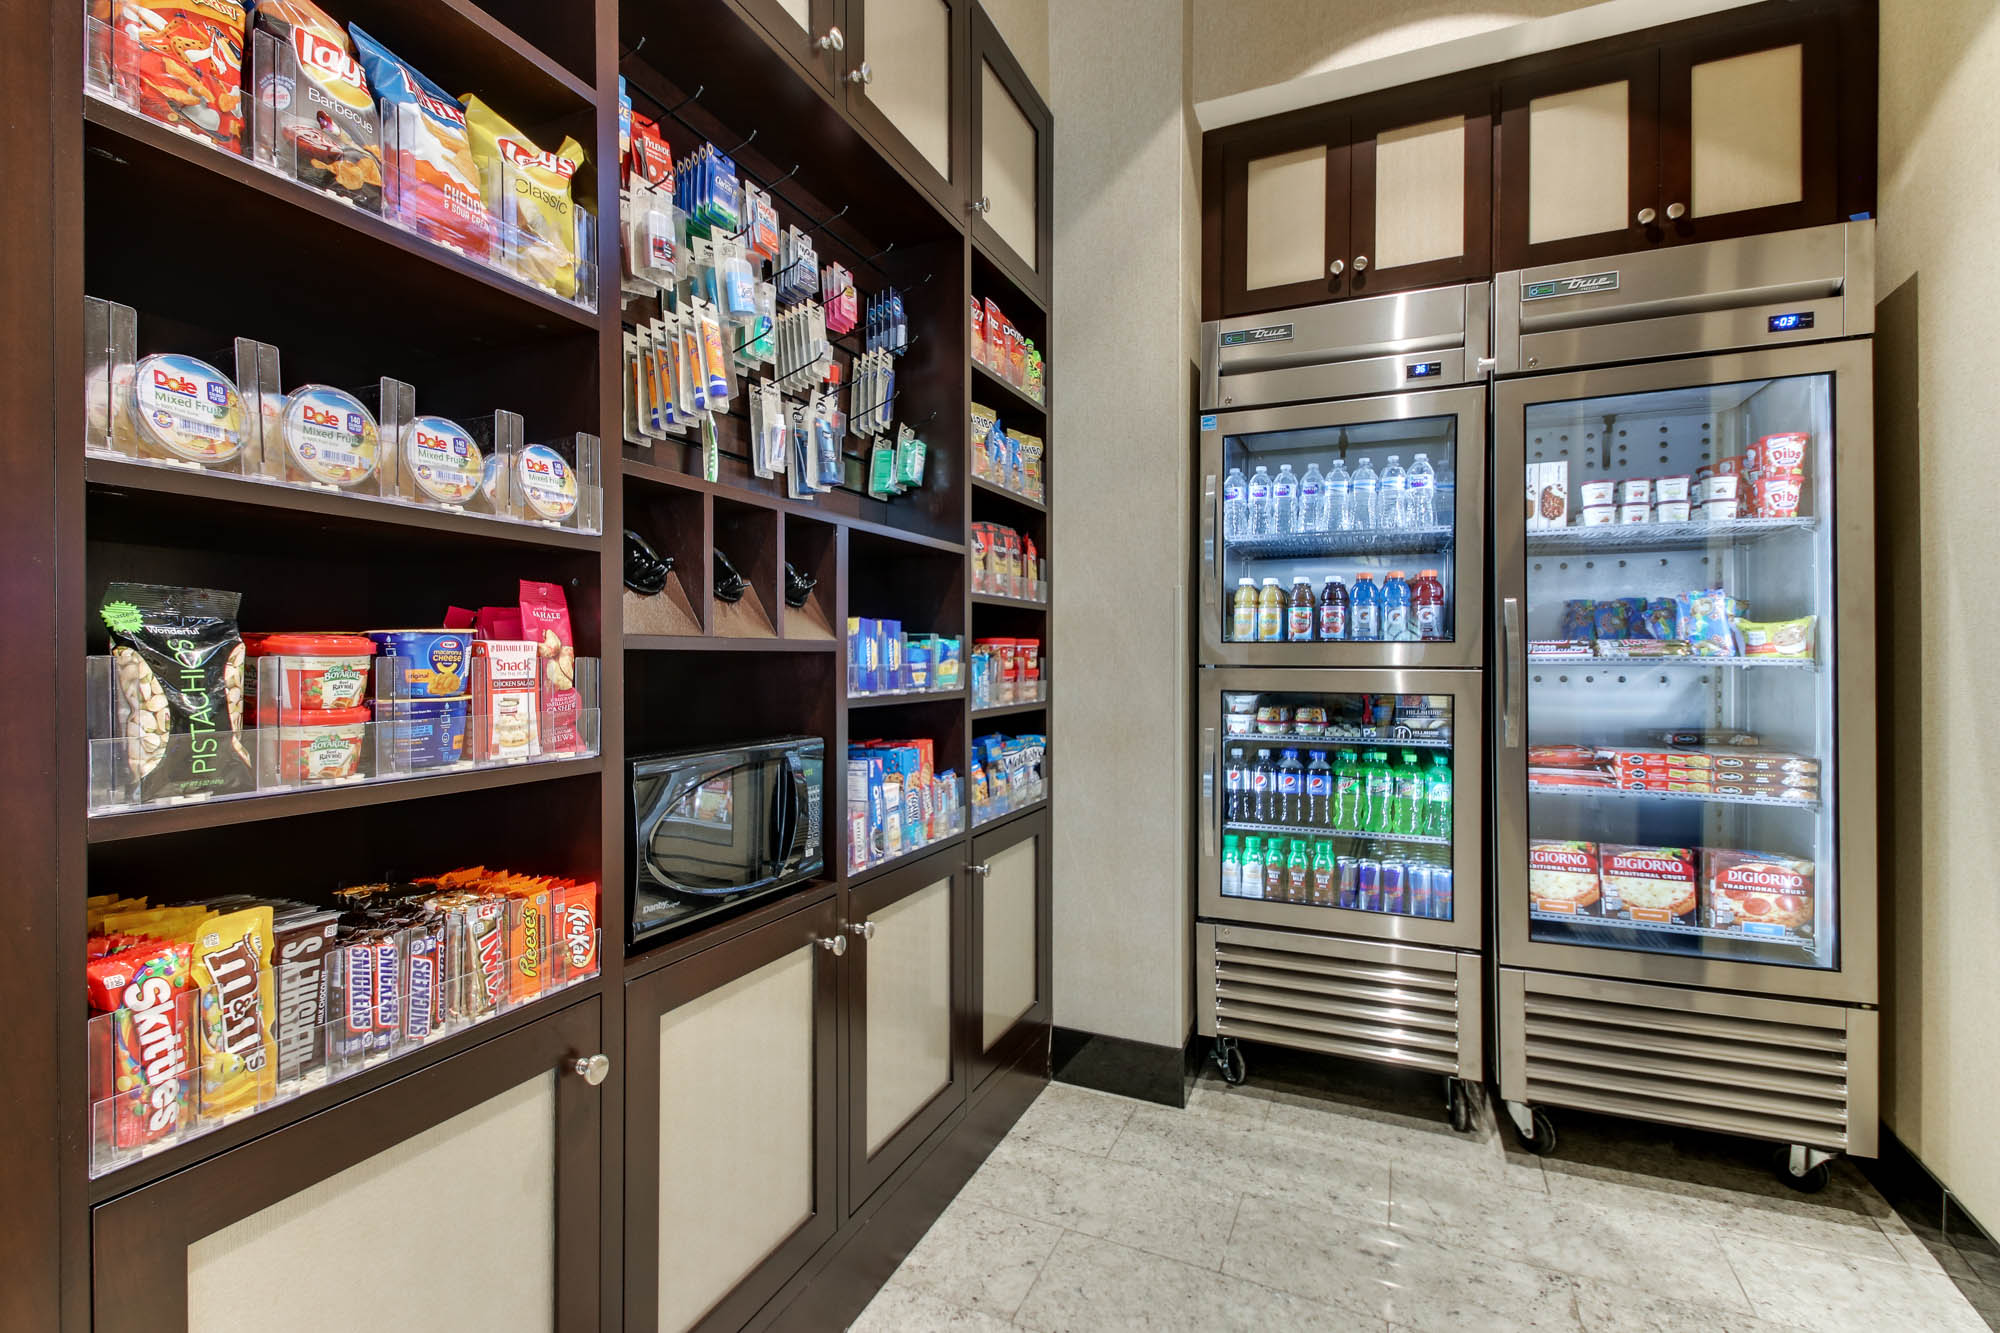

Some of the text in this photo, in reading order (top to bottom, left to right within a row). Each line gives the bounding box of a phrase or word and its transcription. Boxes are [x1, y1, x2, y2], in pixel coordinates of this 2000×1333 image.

[308, 87, 372, 133] Barbecue
[515, 178, 568, 214] Classic
[1560, 277, 1611, 290] True
[1249, 328, 1288, 339] True
[1415, 365, 1427, 374] 36
[153, 369, 198, 395] Dole
[155, 391, 192, 409] Mixed
[303, 405, 340, 426] Dole
[303, 426, 334, 440] Mixed
[416, 431, 448, 450] Dole
[418, 449, 445, 462] Mixed
[1772, 447, 1801, 461] Dibs
[146, 625, 199, 635] Wonderful
[496, 659, 532, 671] Snack
[1362, 727, 1377, 738] P3
[1530, 851, 1588, 866] IGIORNO
[1613, 857, 1683, 873] DIGIORNO
[1608, 869, 1687, 881] TRADITIONAL CRUST
[1727, 870, 1803, 888] DIGIORNO
[1722, 883, 1807, 896] TRADITIONAL CRUST
[519, 907, 537, 978] Reese's
[351, 947, 371, 1029] SNICKERS
[411, 957, 431, 1036] SNICKERS
[317, 1002, 326, 1024] MILK
[124, 977, 185, 1131] Skittles
